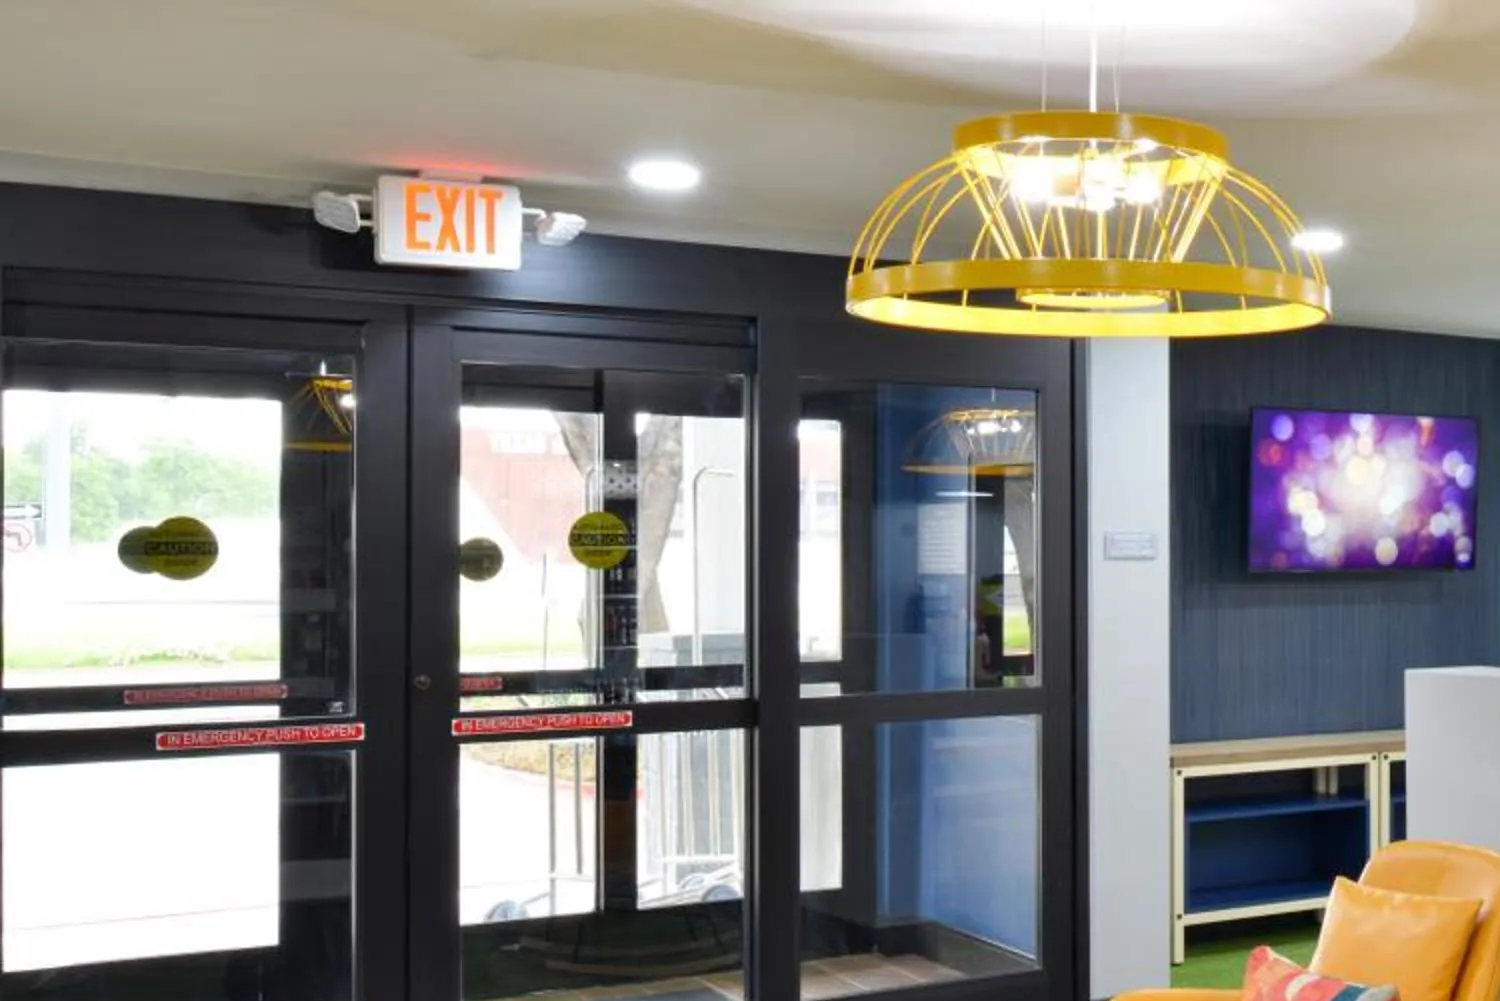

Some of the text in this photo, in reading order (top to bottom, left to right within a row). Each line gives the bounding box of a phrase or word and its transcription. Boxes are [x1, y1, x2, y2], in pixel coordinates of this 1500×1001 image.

[404, 182, 504, 255] EXIT
[146, 543, 217, 554] CAUTION
[462, 719, 473, 733] IN
[475, 715, 545, 730] EMERGENCY
[548, 712, 577, 727] PUSH
[595, 711, 625, 724] OPEN
[167, 726, 356, 745] IN EMERGENCY PUSH TO OPEN
